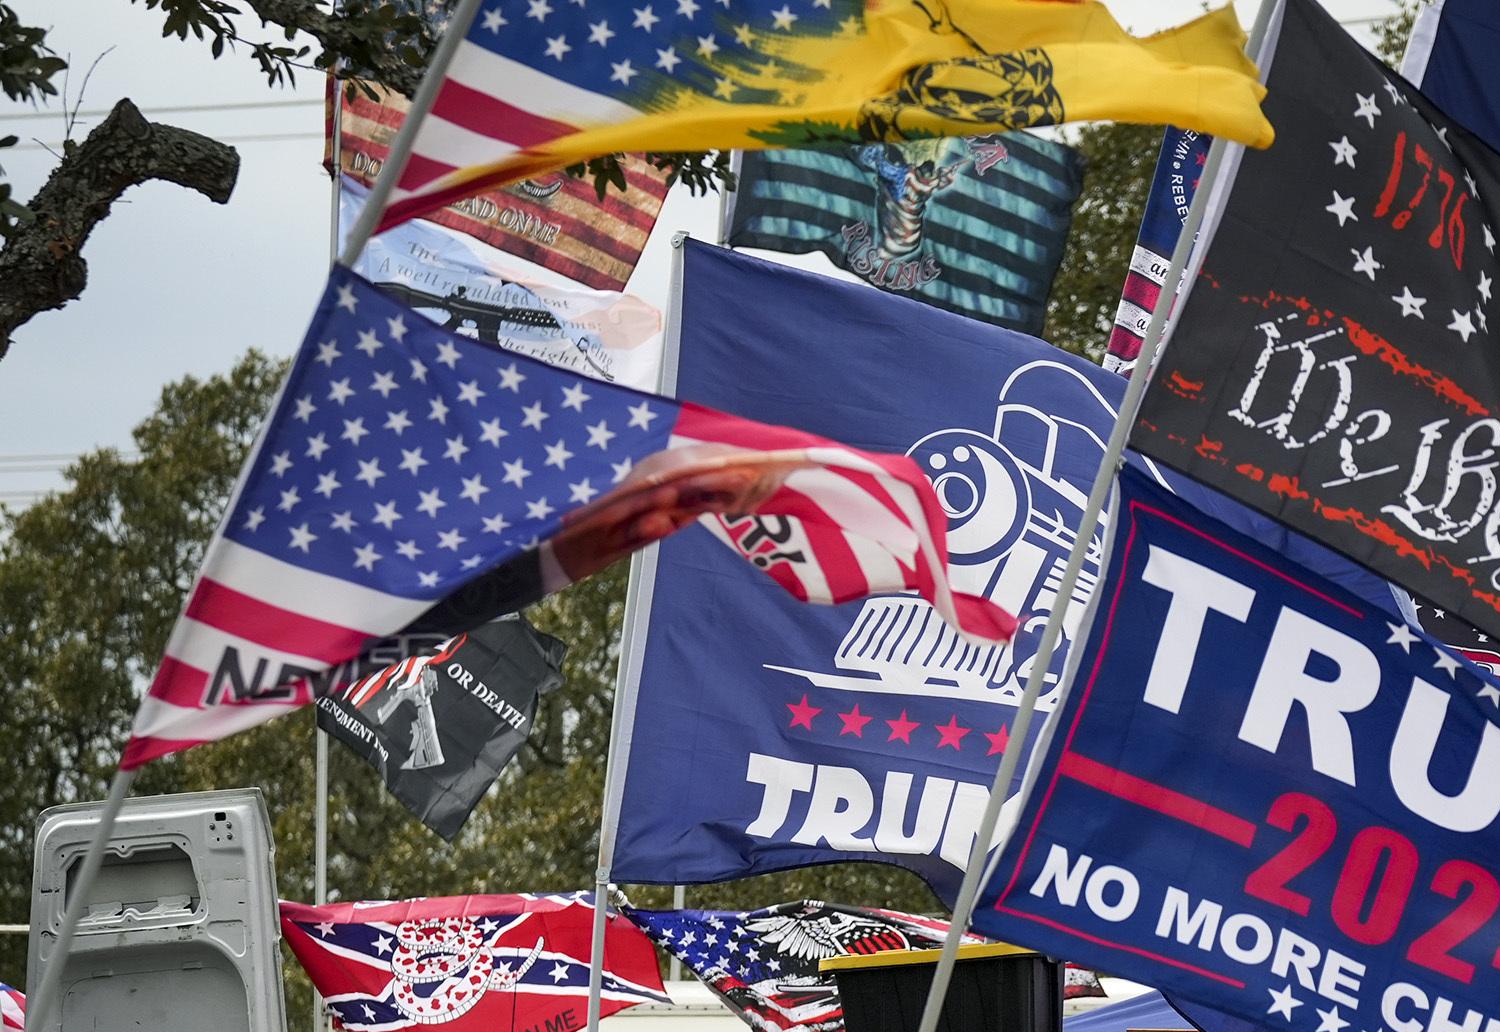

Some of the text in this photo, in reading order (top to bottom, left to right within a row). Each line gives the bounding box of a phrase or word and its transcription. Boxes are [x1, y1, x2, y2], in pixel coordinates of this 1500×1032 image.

[500, 212, 532, 235] ON
[530, 219, 562, 247] ME
[447, 663, 527, 730] OR DEATH
[1029, 844, 1142, 923] NO
[1154, 886, 1367, 1010] MORE
